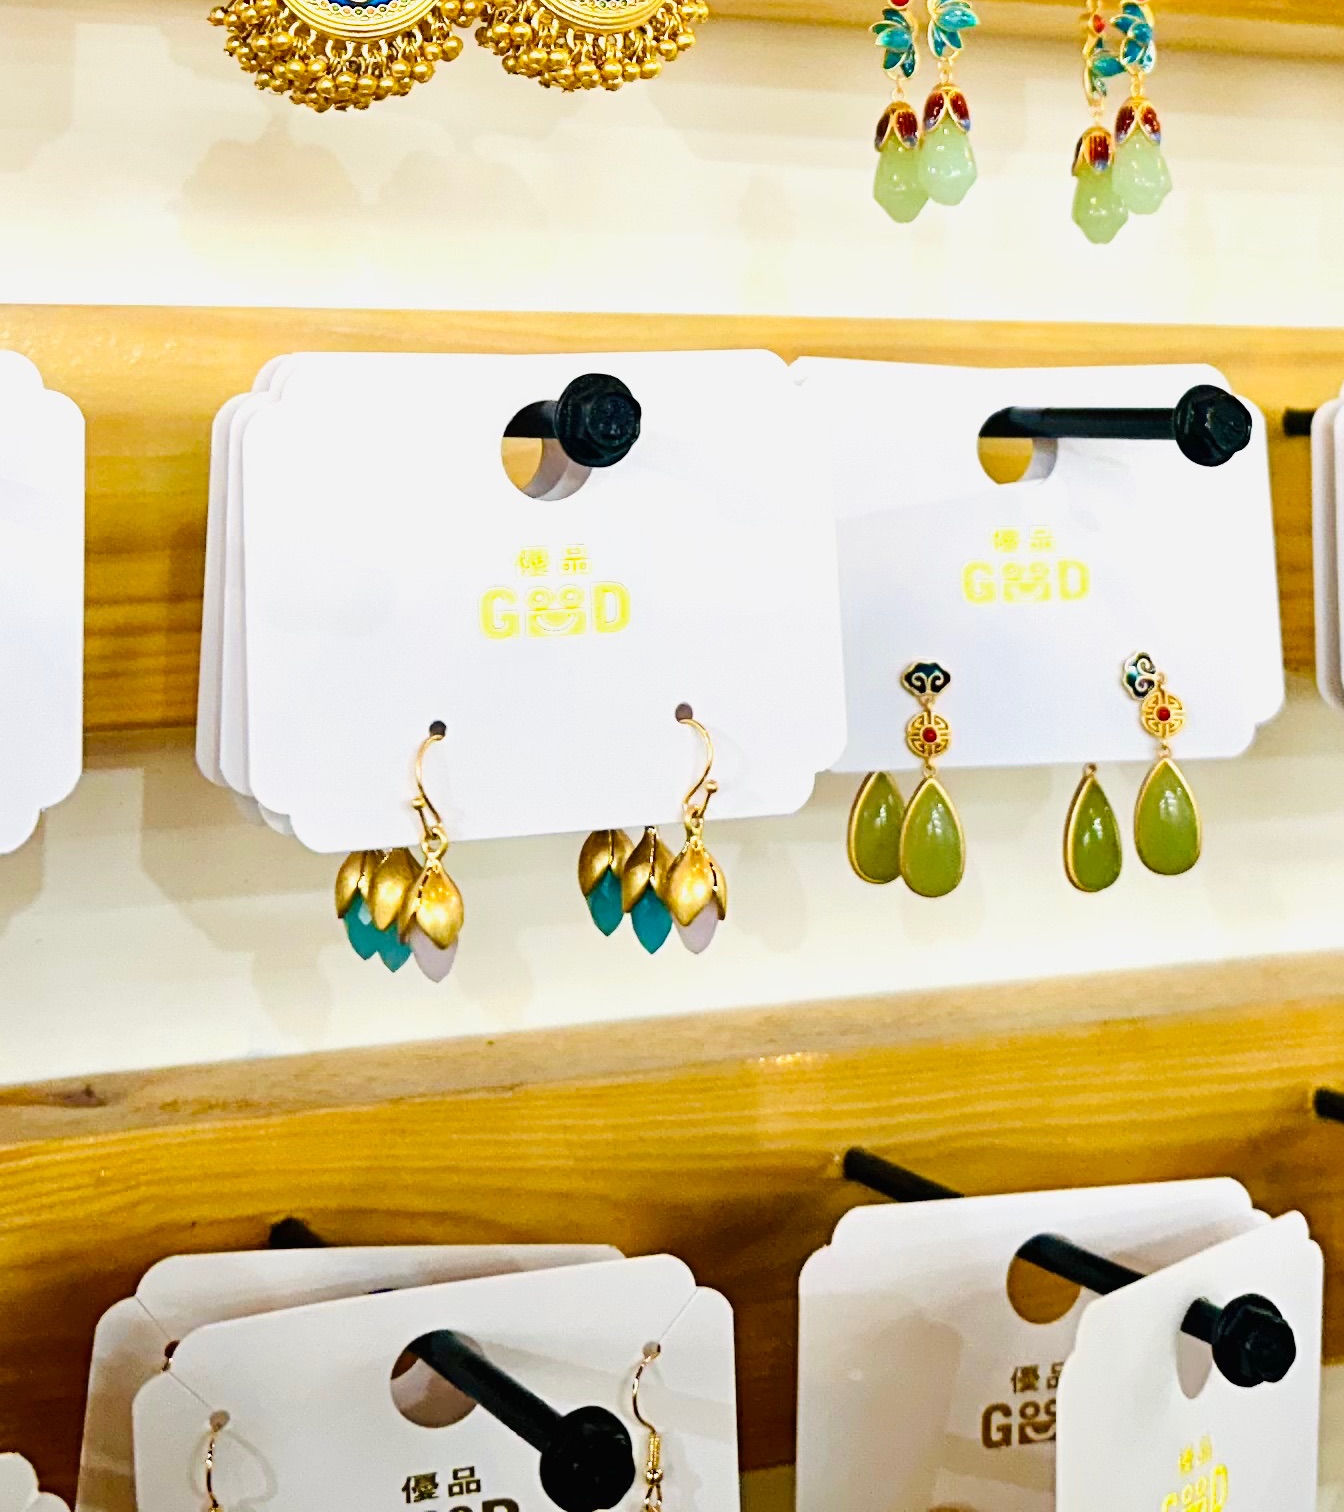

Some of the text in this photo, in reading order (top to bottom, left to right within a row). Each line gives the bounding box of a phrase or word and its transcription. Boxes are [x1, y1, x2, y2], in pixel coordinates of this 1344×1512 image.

[961, 560, 1090, 604] GOOD
[479, 582, 631, 639] GOOD
[981, 1398, 1057, 1449] GOO
[402, 1466, 481, 1504] 優品
